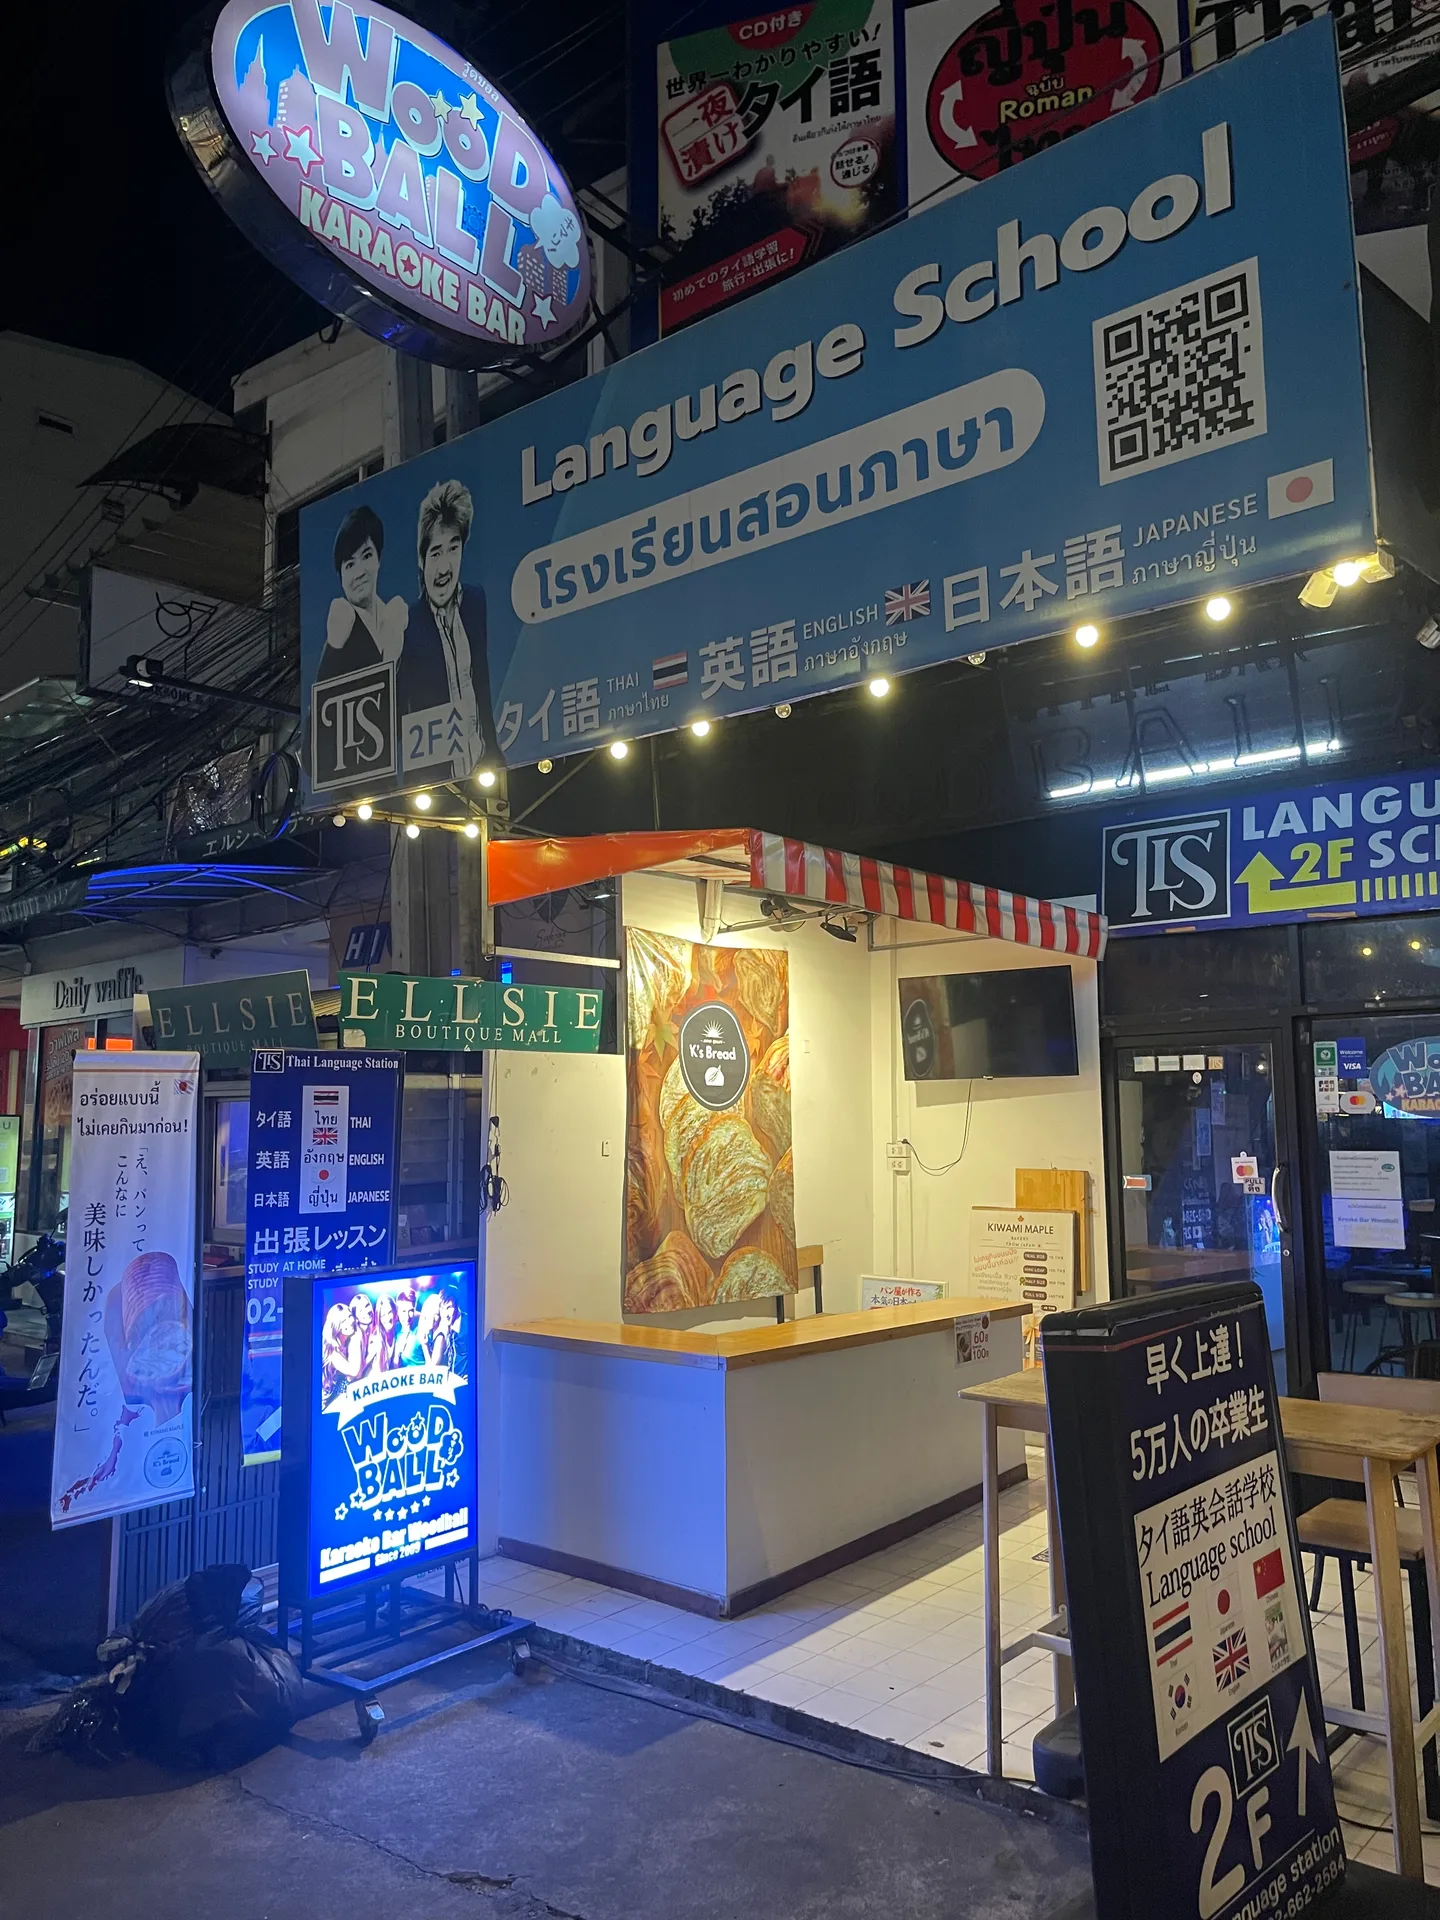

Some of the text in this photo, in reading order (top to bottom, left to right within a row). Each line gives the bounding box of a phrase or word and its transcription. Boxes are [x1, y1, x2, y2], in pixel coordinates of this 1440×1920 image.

[738, 11, 804, 41] CD付き
[735, 48, 883, 140] タイ語
[1000, 84, 1094, 124] Roman
[1025, 75, 1065, 97] ฉบับ
[289, 0, 549, 225] WOOD
[315, 95, 527, 309] BALL
[300, 180, 527, 345] KARAOKE BAR
[672, 240, 780, 303] 初めてのタイ語学習
[521, 121, 1232, 507] Language School
[534, 406, 1015, 610] โรงเรียนสอนภาษา
[1132, 493, 1258, 548] JAPANESE
[942, 524, 1126, 633] 日本語
[1132, 533, 1257, 585] ภาษาญี่ปุ่น
[802, 603, 880, 641] ENGLISH
[699, 619, 799, 700] 英語
[804, 629, 909, 672] ภาษาอังกฤษ
[606, 671, 640, 694] THAI
[496, 677, 601, 751] タイ語
[608, 691, 670, 723] ภาษาไทย
[408, 718, 443, 761] 2F
[1289, 838, 1354, 884] 2F
[1367, 823, 1440, 869] SC
[53, 966, 144, 1014] Daily waffle
[346, 976, 600, 1030] ELLSIE
[156, 991, 308, 1038] ELLSIE
[395, 1024, 562, 1044] BOUTIQUE MALL
[286, 1055, 399, 1071] Thai Language Station
[689, 1043, 737, 1060] K's Bread
[1343, 1062, 1362, 1070] VISA
[79, 1081, 161, 1107] อร่อยแบบนี้
[77, 1116, 188, 1137] ไม่เคยกินมาก่อน!
[256, 1110, 292, 1128] タイ語
[314, 1110, 338, 1126] ไทย
[350, 1116, 372, 1129] THAI
[255, 1150, 291, 1170] 英語
[303, 1147, 345, 1165] อังกฤษ
[349, 1153, 385, 1166] ENGLISH
[114, 1154, 129, 1218] こんなに
[253, 1191, 290, 1208] 日本語
[308, 1185, 338, 1208] ญี่ปุ่น
[347, 1189, 390, 1204] JAPANESE
[253, 1224, 387, 1255] 出張レッスン
[988, 1222, 1054, 1235] KIWAMI MAPLE
[247, 1277, 279, 1290] STUDY
[248, 1262, 279, 1275] STUDY
[282, 1260, 295, 1271] AT
[297, 1258, 326, 1271] HOME
[880, 1286, 922, 1297] パン屋が作る
[352, 1373, 444, 1402] KARAOKE BAR
[341, 1404, 454, 1467] WOOD
[1130, 1384, 1269, 1482] 5万人の卒業生
[356, 1447, 445, 1510] BALL
[1139, 1464, 1277, 1568] タイ語英会話学校
[1146, 1506, 1278, 1608] Language school
[1190, 1765, 1272, 1920] 2F
[1290, 1826, 1341, 1882] station
